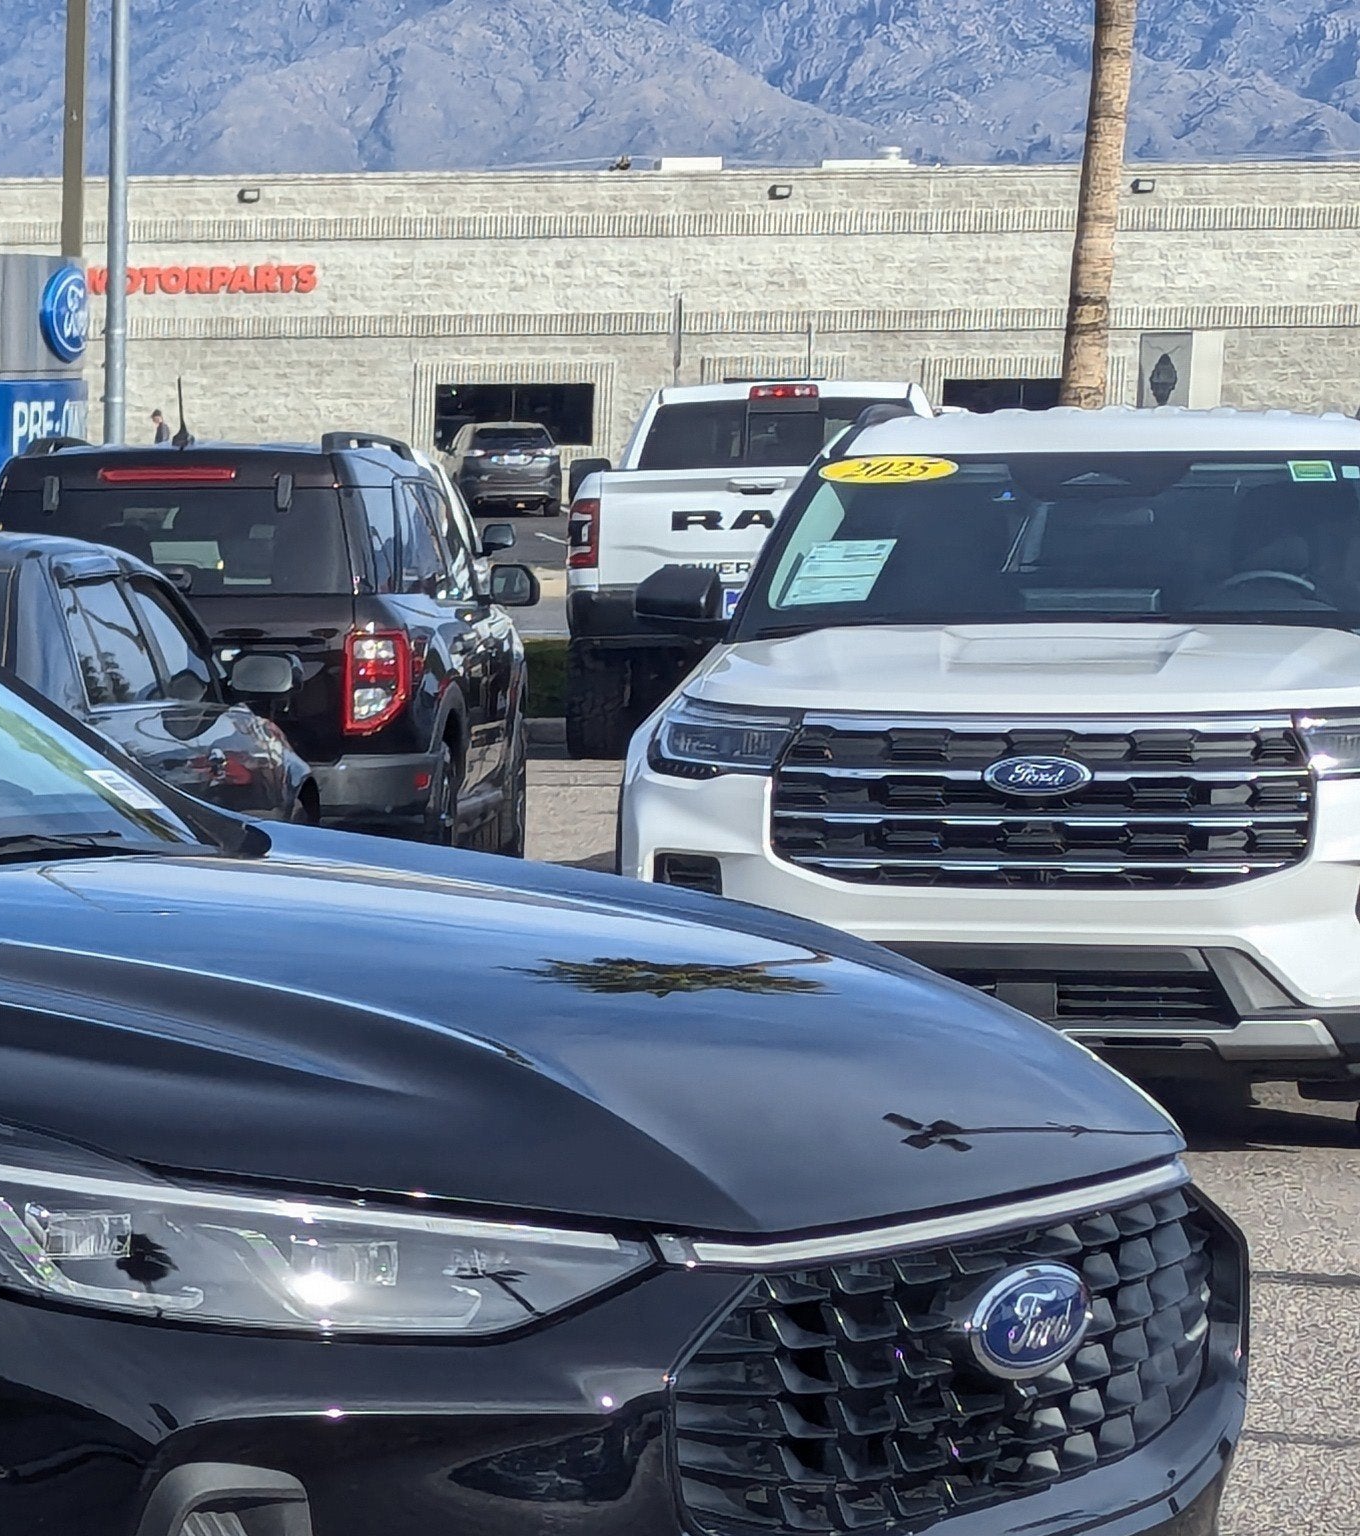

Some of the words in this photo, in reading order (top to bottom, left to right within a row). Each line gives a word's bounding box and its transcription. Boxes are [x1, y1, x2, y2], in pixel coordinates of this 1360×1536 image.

[840, 461, 941, 478] 2025
[671, 509, 775, 531] RA
[1008, 764, 1065, 785] Ford
[1008, 1289, 1073, 1354] Ford
